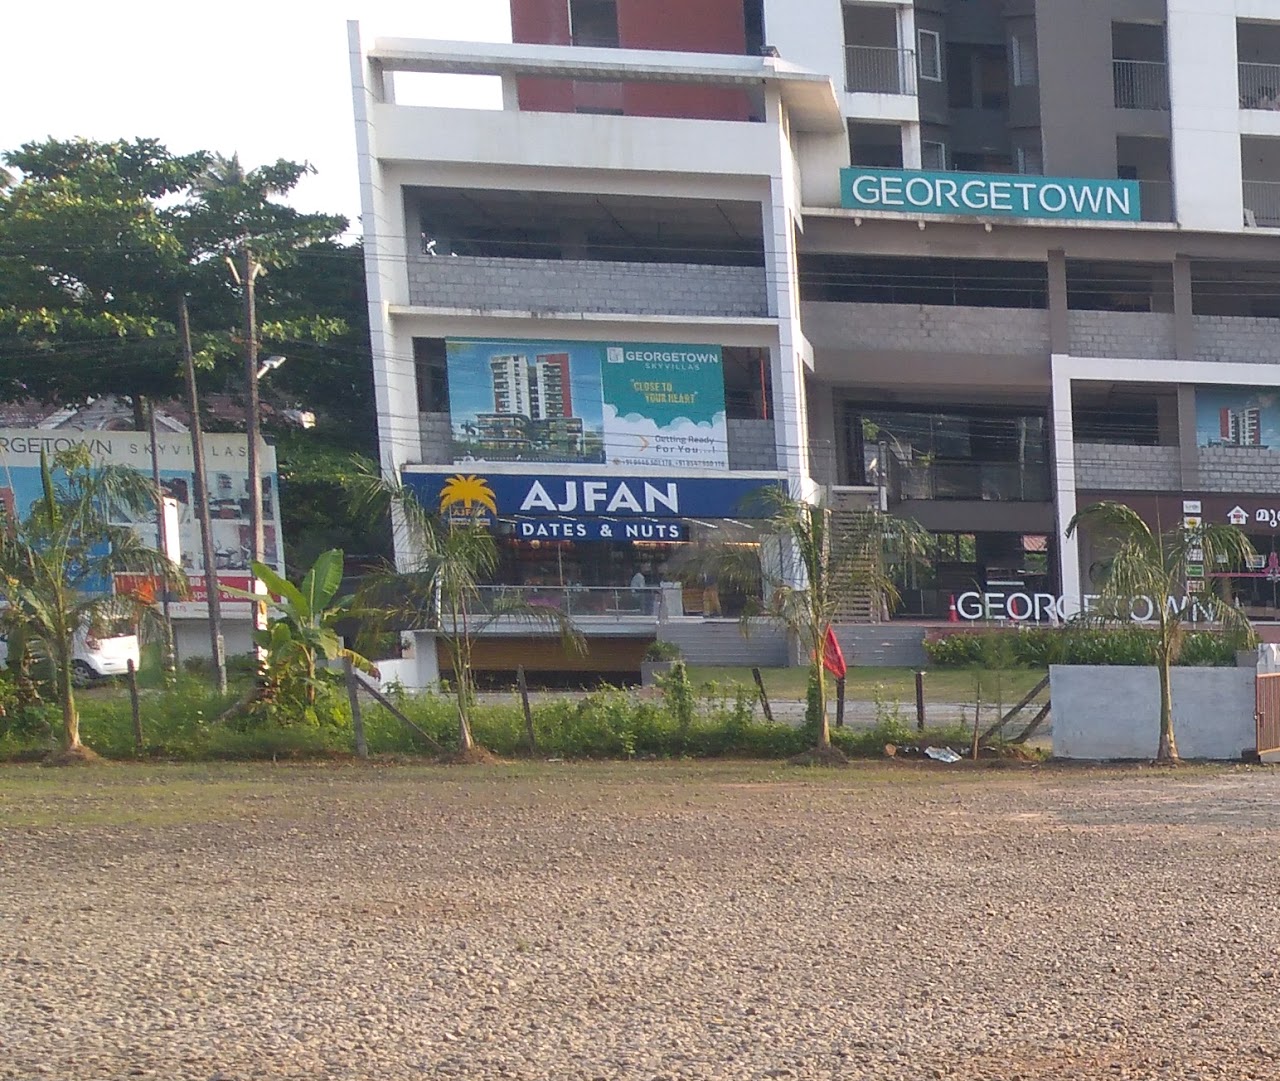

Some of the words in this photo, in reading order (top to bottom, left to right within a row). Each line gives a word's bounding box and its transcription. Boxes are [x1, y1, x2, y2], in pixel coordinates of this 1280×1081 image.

[852, 175, 1130, 215] GEORGETOWN
[625, 351, 719, 363] GEORGETOWN
[645, 362, 701, 371] SKYVILLAS
[655, 435, 687, 445] Getting
[688, 436, 715, 445] Ready
[129, 443, 247, 457] SKYVILAS
[656, 444, 675, 453] For
[520, 479, 678, 513] AJFAN
[522, 523, 587, 537] DATES
[600, 523, 613, 538] &
[626, 524, 680, 538] NUTS
